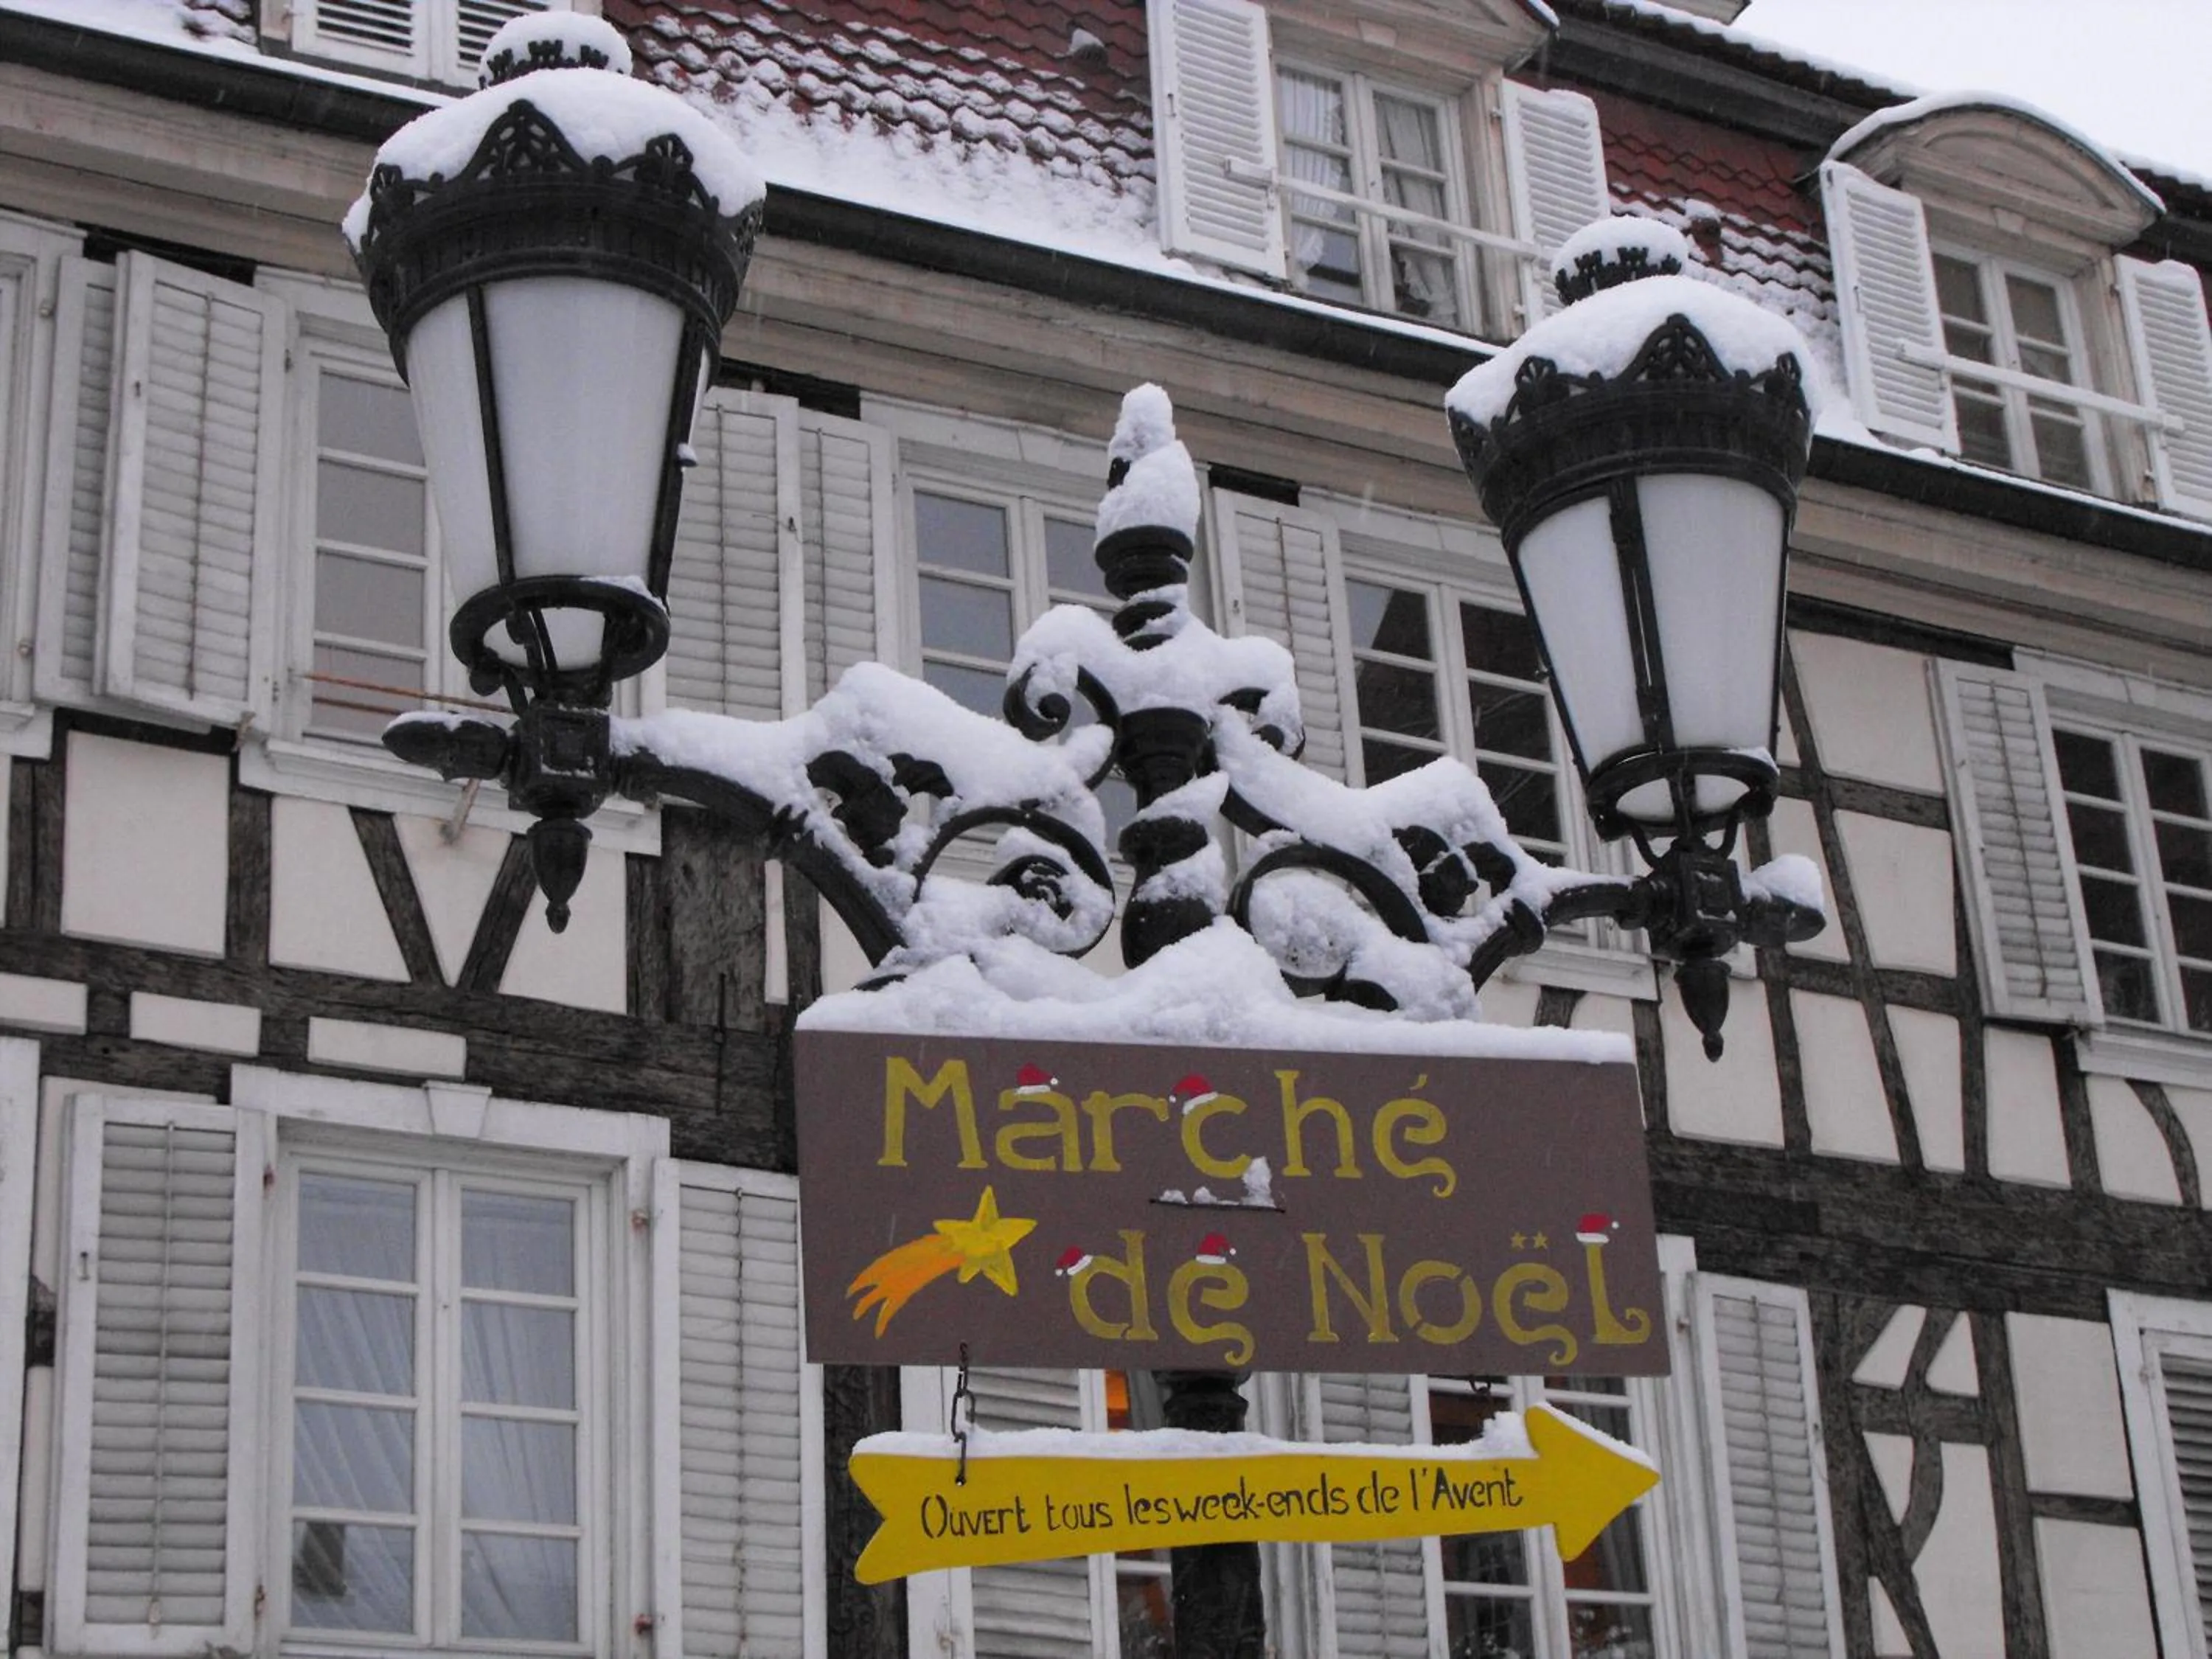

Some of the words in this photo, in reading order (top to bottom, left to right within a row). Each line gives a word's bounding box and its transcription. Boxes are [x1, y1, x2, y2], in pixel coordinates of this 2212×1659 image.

[878, 1055, 1458, 1199] Marché
[1069, 1230, 1253, 1366] de
[921, 1495, 1031, 1539] Ouvert
[1046, 1495, 1113, 1531] tous
[1356, 1470, 1399, 1514] de
[1410, 1467, 1523, 1512] l'Avent
